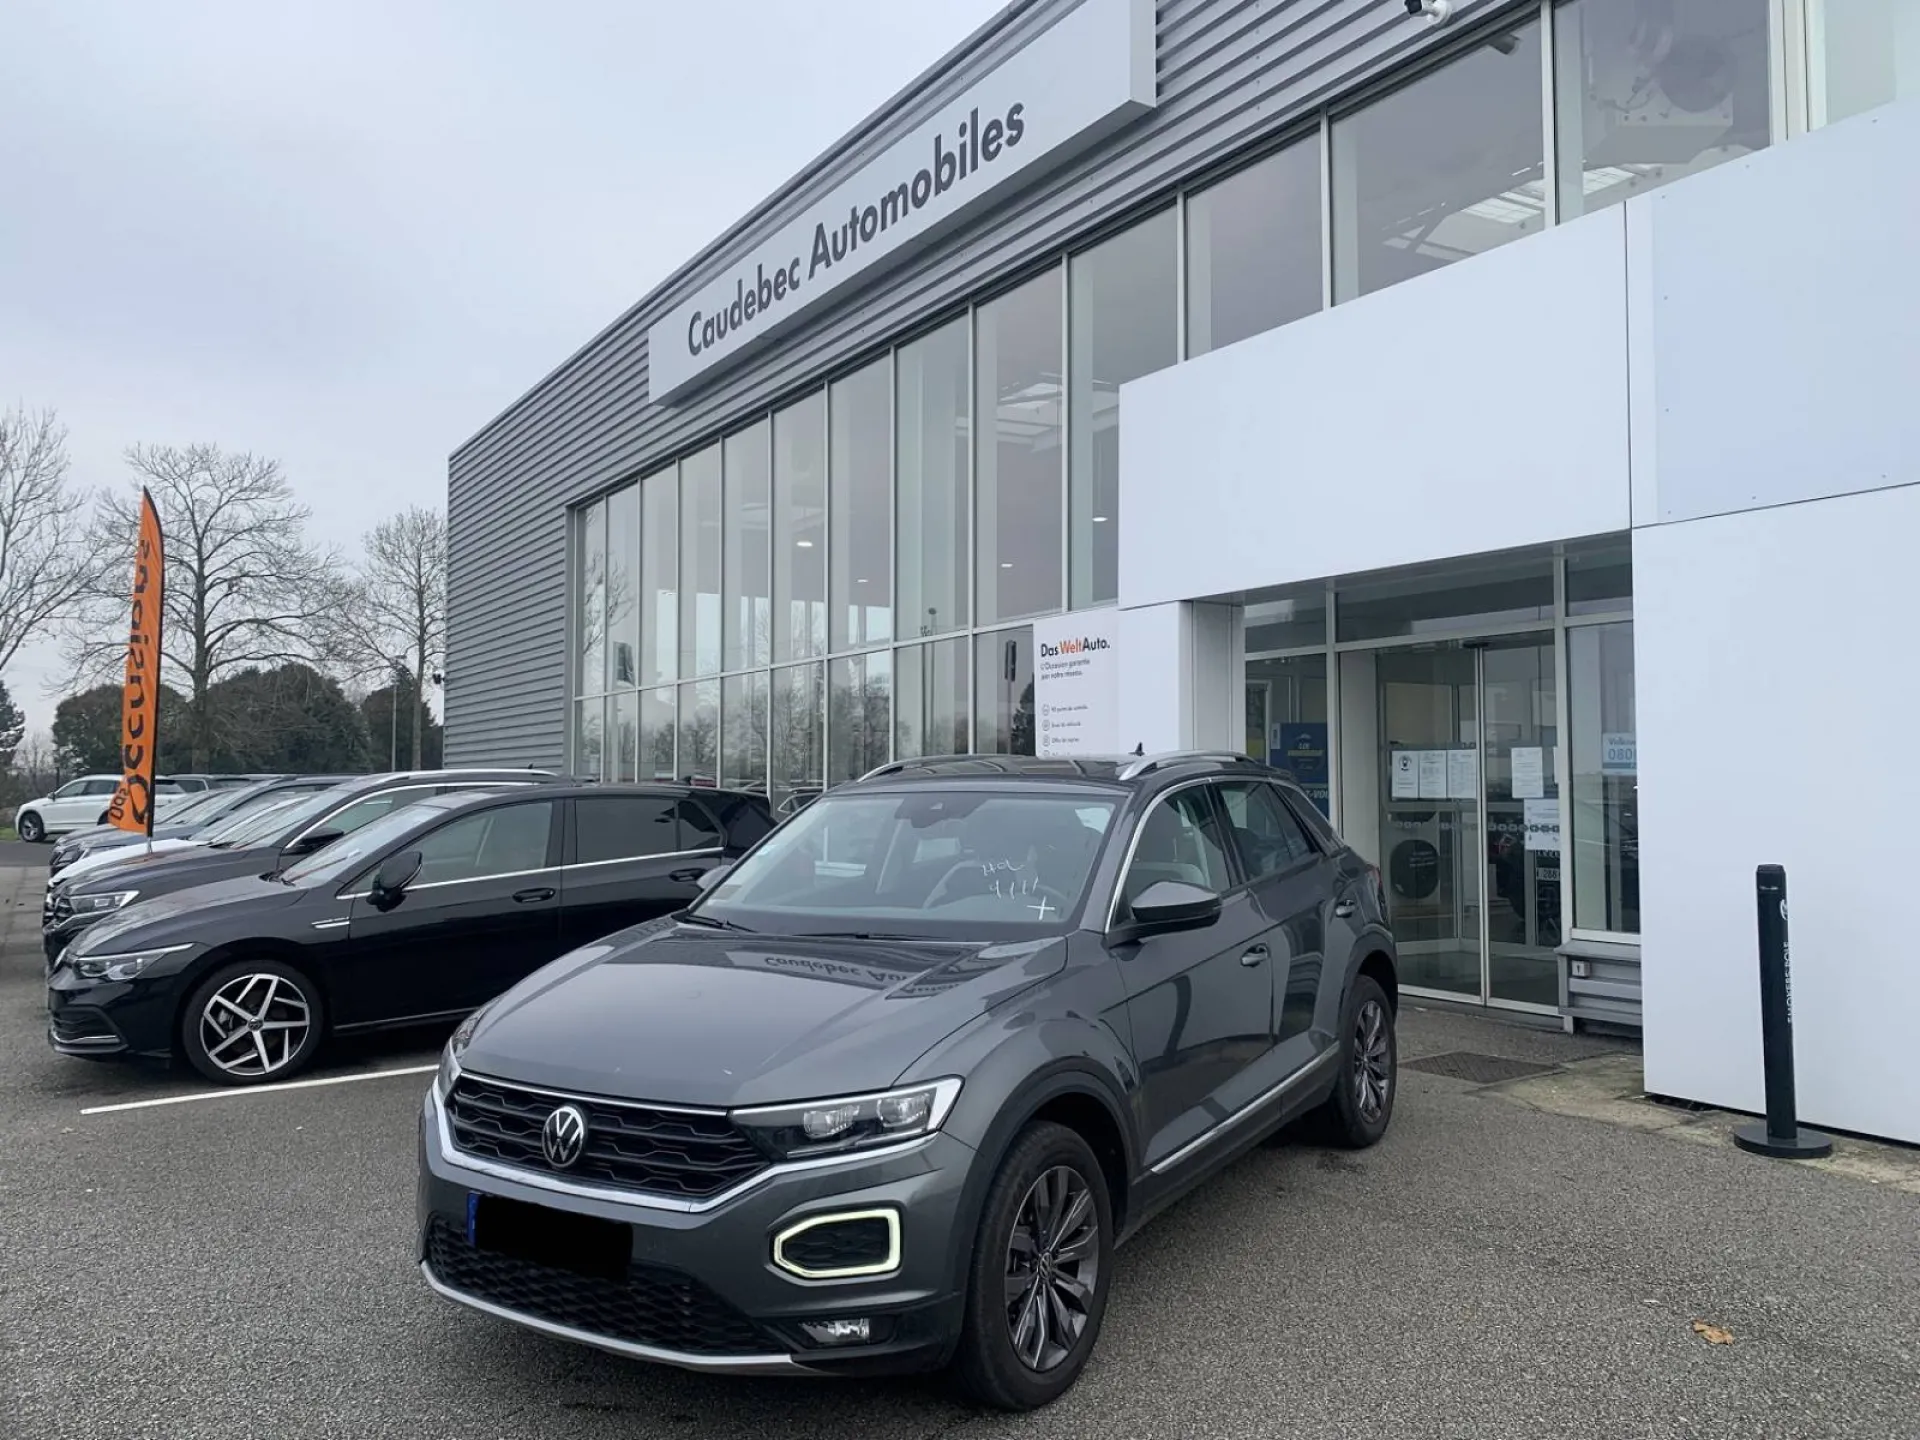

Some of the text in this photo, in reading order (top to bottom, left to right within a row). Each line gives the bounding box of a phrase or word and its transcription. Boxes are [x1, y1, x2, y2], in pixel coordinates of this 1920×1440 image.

[688, 102, 1024, 356] Caudebec Automobiles
[1040, 643, 1059, 657] Das
